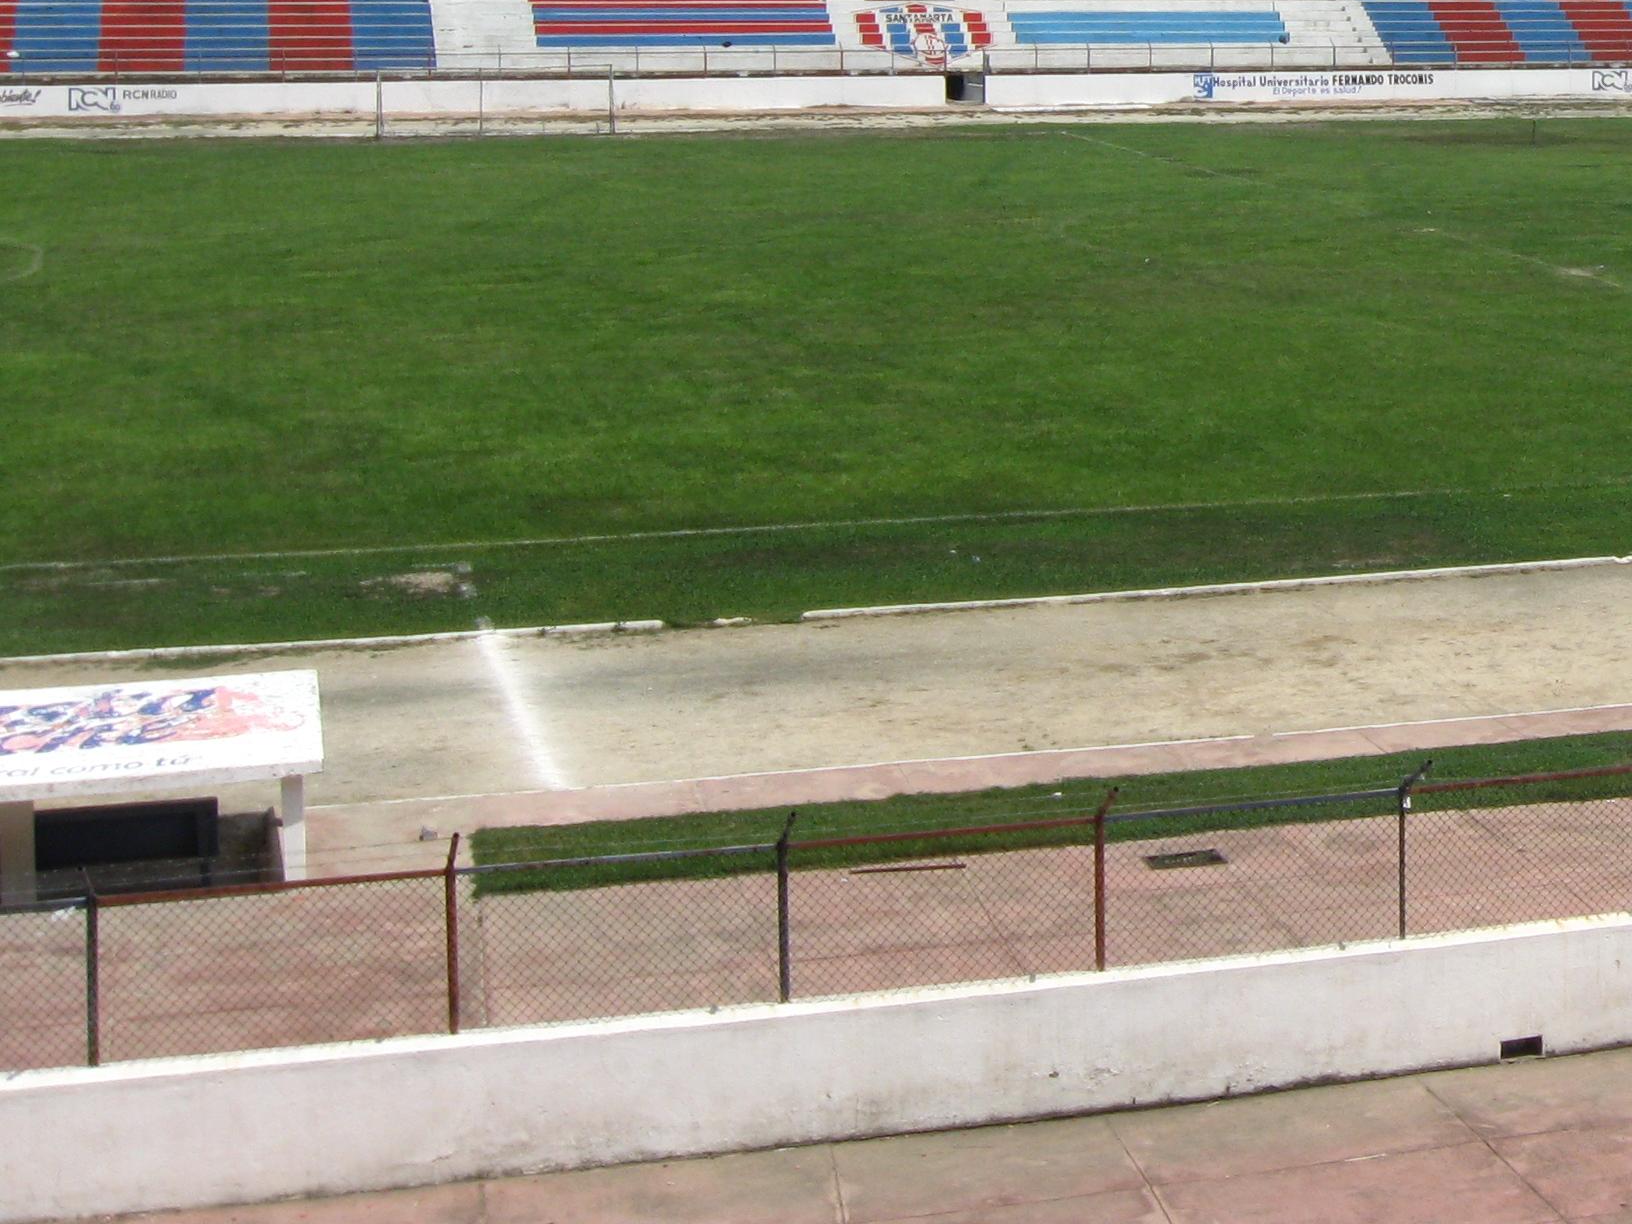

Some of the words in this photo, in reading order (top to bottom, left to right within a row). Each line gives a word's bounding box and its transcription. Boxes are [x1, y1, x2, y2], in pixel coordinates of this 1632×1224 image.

[1213, 77, 1256, 89] Hospital
[1260, 76, 1329, 87] Universitario
[1332, 74, 1384, 86] FERNANDO
[1388, 74, 1434, 84] TROCONIS
[68, 87, 116, 111] RCN
[123, 90, 149, 100] RCN
[150, 89, 177, 99] RADIO
